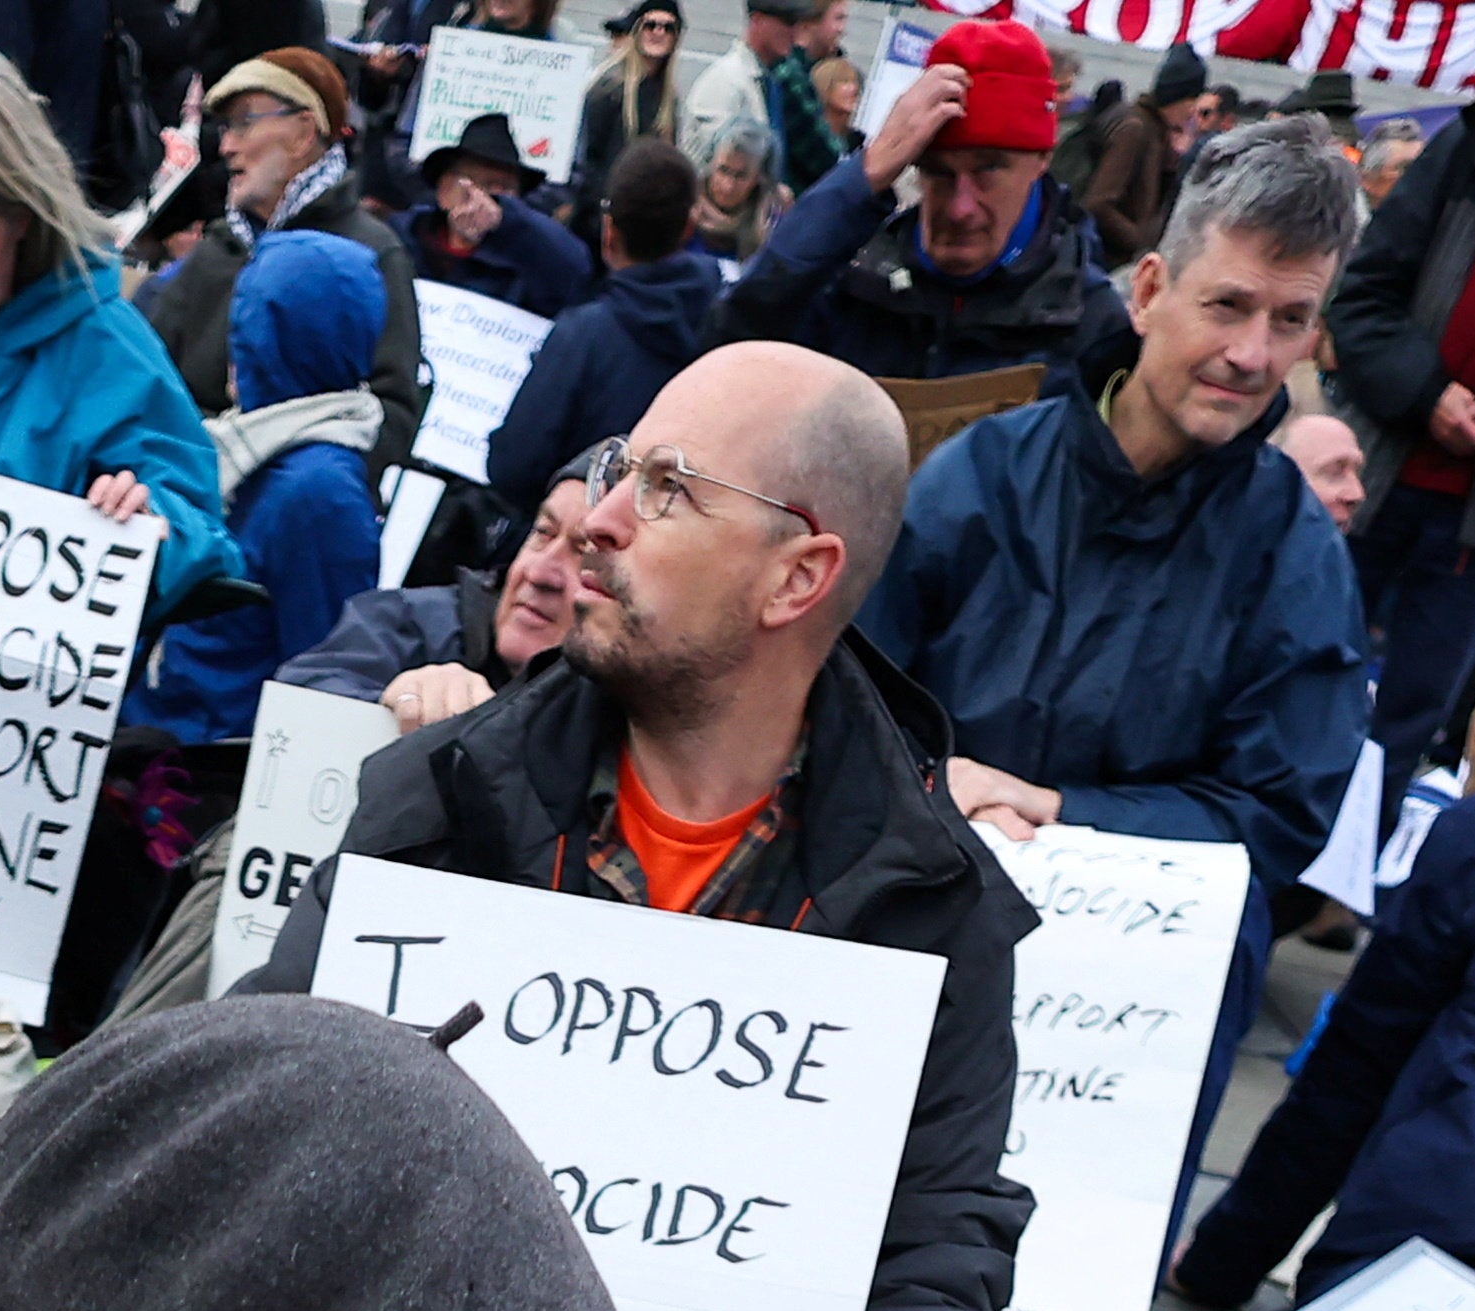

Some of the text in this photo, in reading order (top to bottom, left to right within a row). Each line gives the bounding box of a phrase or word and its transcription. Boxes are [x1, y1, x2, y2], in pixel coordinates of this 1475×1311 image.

[354, 934, 853, 1105] I OPPOSE
[1012, 993, 1181, 1046] PPORT
[541, 1161, 791, 1264] OCIDE
